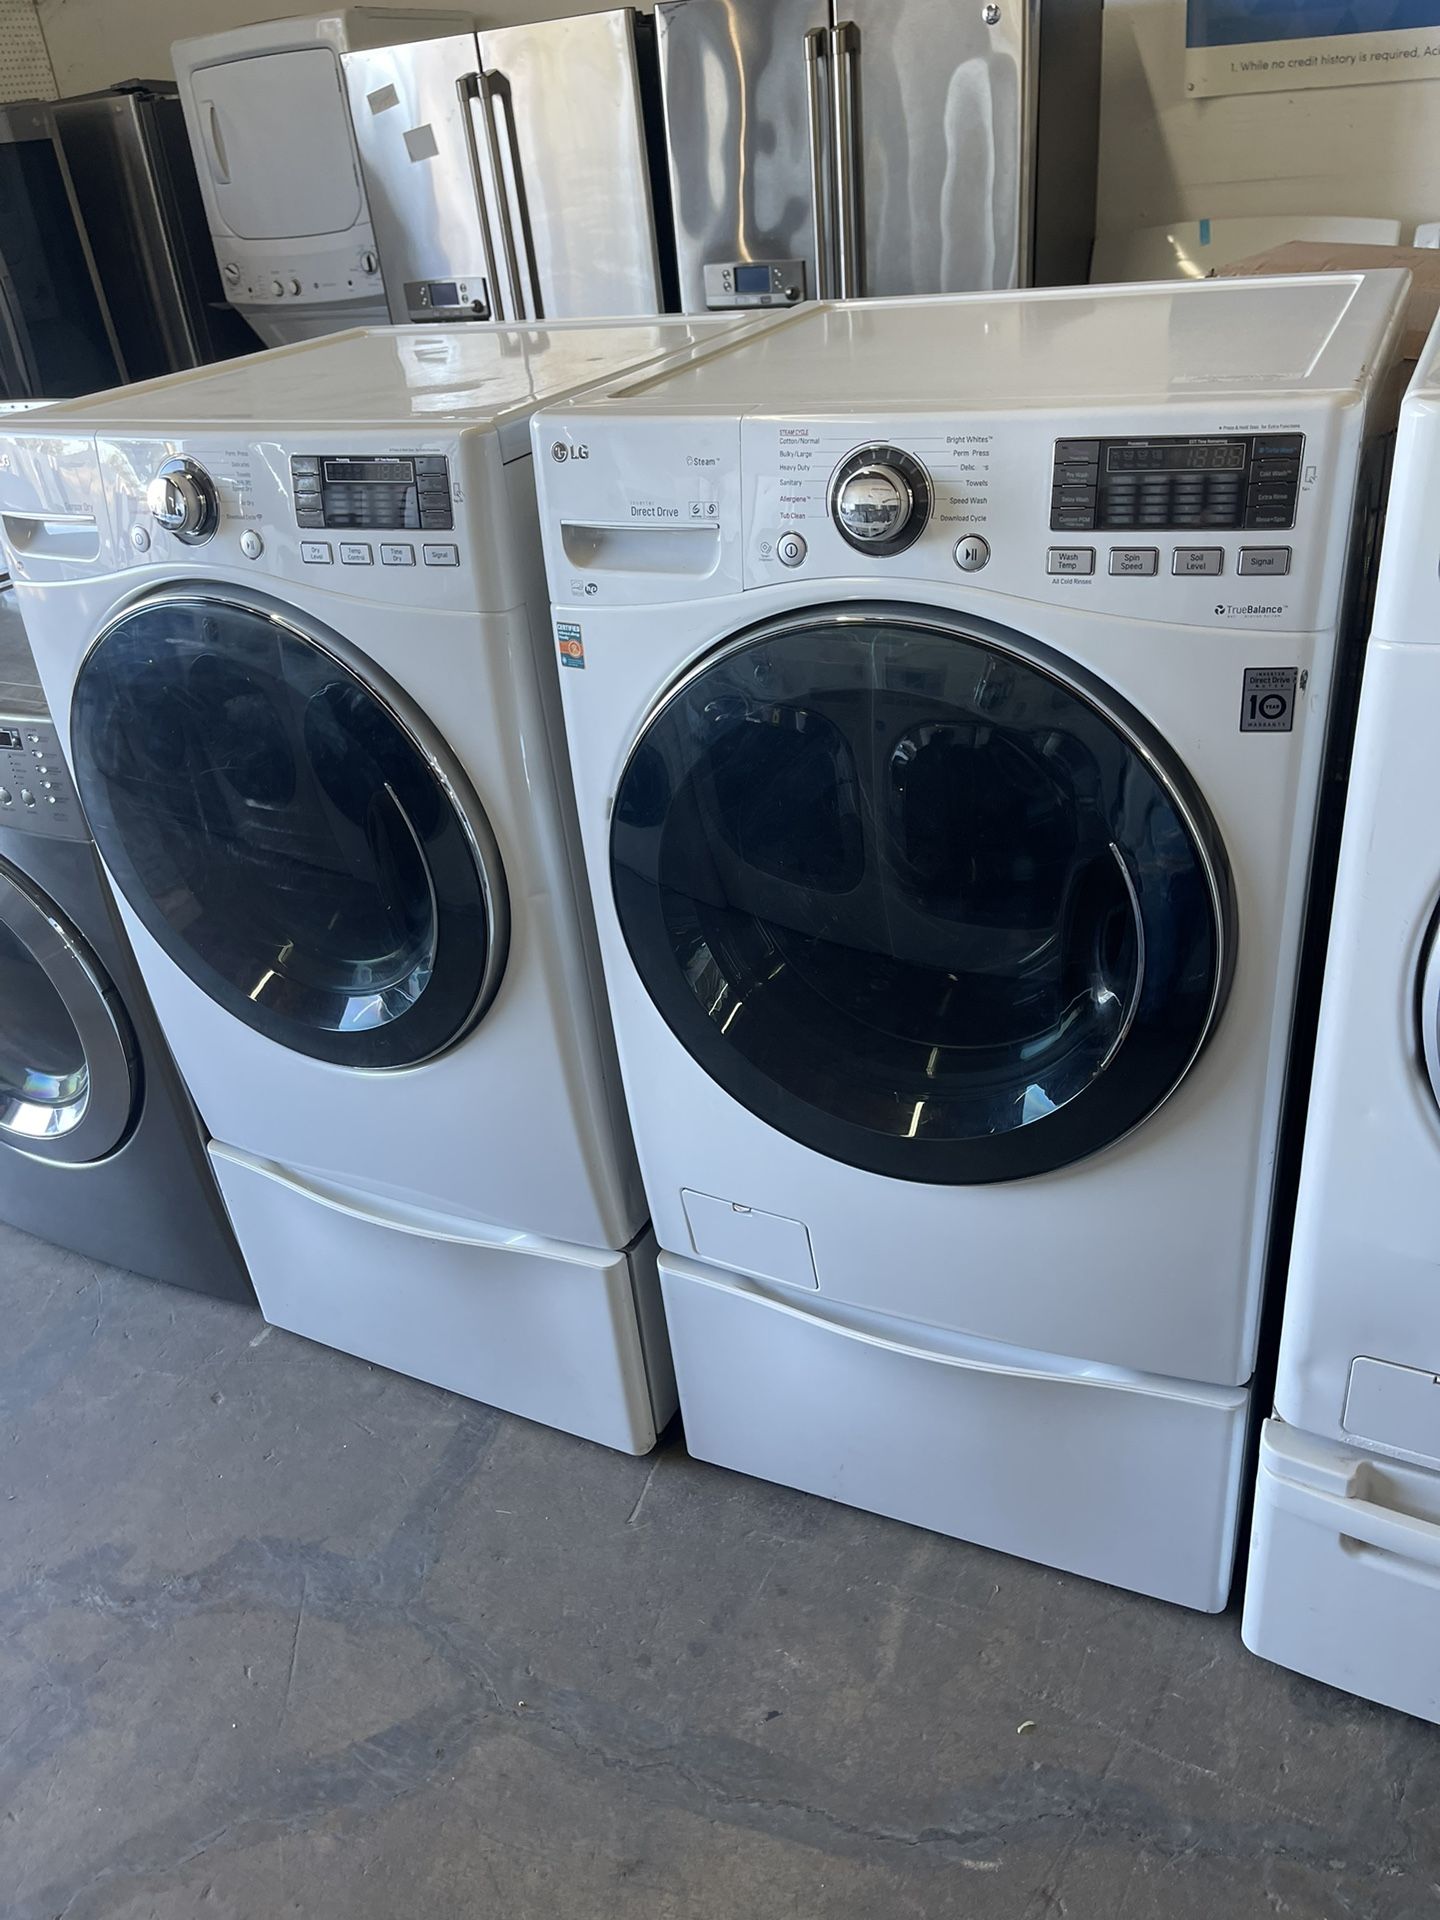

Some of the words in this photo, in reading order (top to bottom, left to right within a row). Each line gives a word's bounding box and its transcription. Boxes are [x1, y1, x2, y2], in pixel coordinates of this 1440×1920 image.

[1240, 61, 1269, 72] While
[1271, 60, 1286, 70] no
[1288, 56, 1318, 68] credit
[1320, 54, 1356, 67] history
[1358, 53, 1367, 62] is
[946, 436, 965, 444] Bright
[779, 450, 812, 458] Bulky/Large
[779, 479, 802, 487] Sanitary
[949, 497, 969, 505] Speed
[631, 506, 656, 517] Direct
[657, 506, 679, 517] Drive
[970, 515, 986, 523] Cycle
[1124, 553, 1140, 563] Spin
[1190, 553, 1204, 562] Soil
[1250, 557, 1274, 567] Signal
[1058, 561, 1077, 570] Temp
[1120, 562, 1143, 571] Speed
[1186, 562, 1206, 570] Level
[1250, 694, 1287, 720] 10
